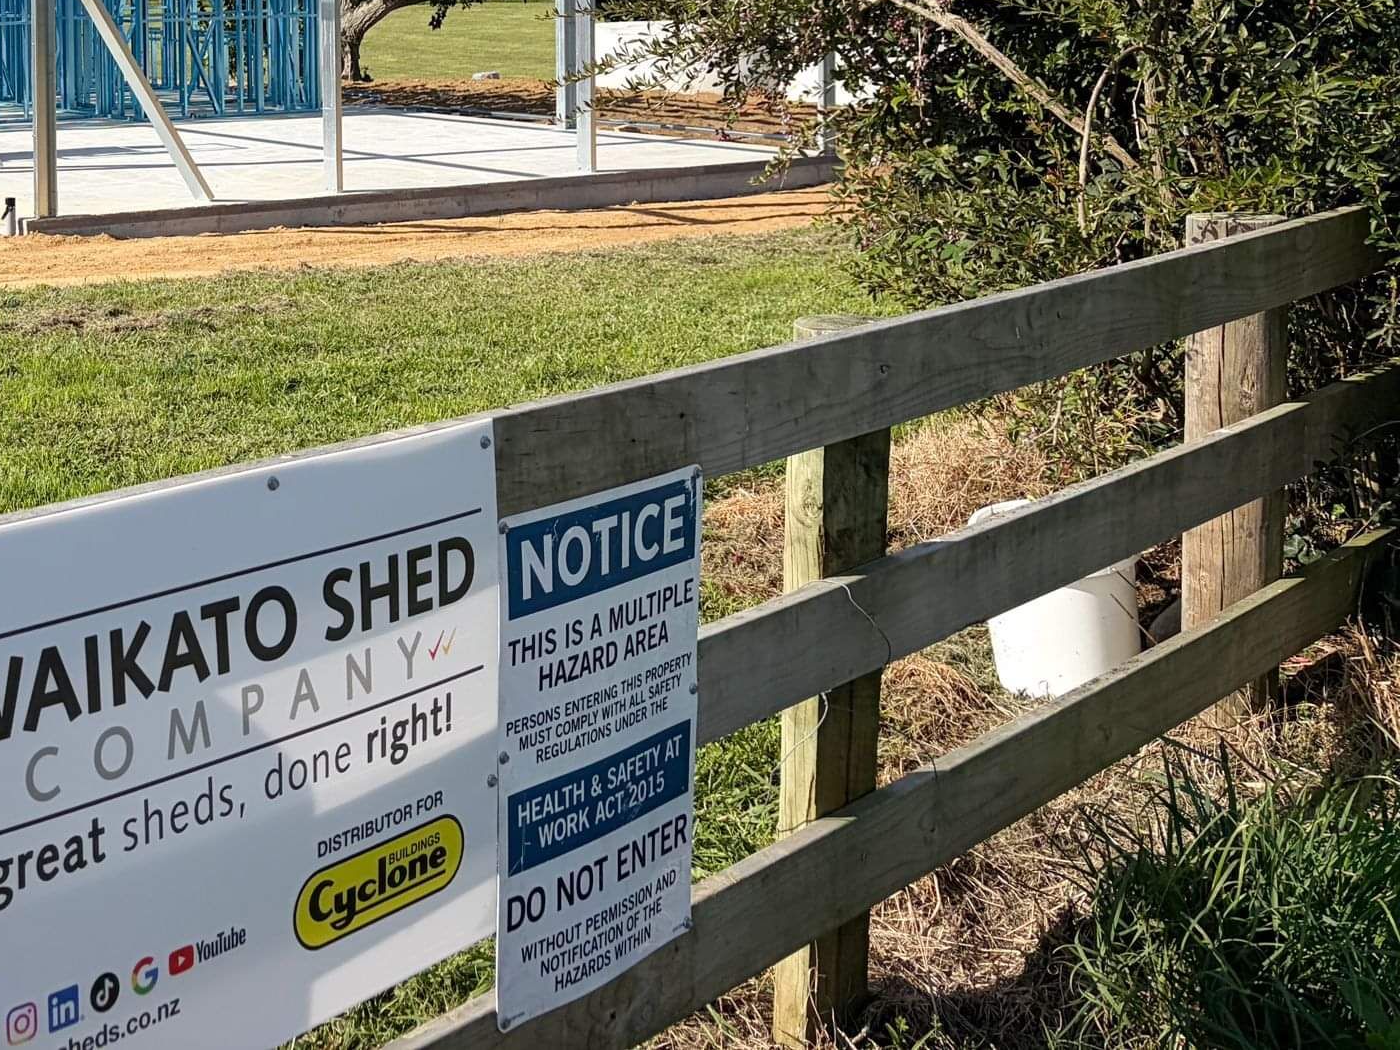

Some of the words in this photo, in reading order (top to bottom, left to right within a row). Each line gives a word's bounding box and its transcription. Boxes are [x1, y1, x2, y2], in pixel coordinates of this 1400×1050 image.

[323, 536, 475, 641] SHED
[521, 494, 686, 600] NOTICE
[508, 628, 556, 666] THIS
[566, 620, 583, 648] IS
[590, 613, 602, 640] A
[609, 578, 694, 632] MULTIPLE
[539, 641, 618, 691] HAZARD
[624, 620, 669, 660] AREA
[25, 631, 421, 802] COMPANY
[506, 706, 560, 736] PERSONS
[564, 685, 618, 716] ENTERING
[621, 674, 642, 694] THIS
[646, 652, 692, 682] PROPERTY
[519, 727, 552, 750] MUST
[556, 710, 599, 738] COMPLY
[602, 699, 626, 720] WITH
[628, 693, 645, 709] ALL
[648, 674, 682, 699] SAFETY
[536, 727, 612, 763] REGULATIONS
[616, 708, 647, 732] UNDER
[650, 696, 668, 715] THE
[123, 776, 246, 851] sheds,
[265, 752, 351, 799] done
[366, 692, 452, 765] right!
[518, 780, 585, 827] HEALTH
[590, 774, 602, 797] &
[608, 744, 661, 790] SAFETY
[664, 734, 683, 762] AT
[538, 807, 590, 848] WORK
[595, 791, 624, 824] ACT
[629, 770, 665, 808] 2015
[318, 804, 412, 857] DISTRIBUTOR
[416, 790, 443, 815] FOR
[389, 832, 441, 865] BUILDINGS
[309, 846, 447, 930] Cyclone
[507, 886, 546, 932] DO
[557, 855, 608, 911] NOT
[617, 814, 688, 882] ENTER
[521, 922, 582, 963] WITHOUT
[586, 882, 652, 934] PERMISSION
[656, 869, 676, 894] AND
[540, 924, 623, 977] NOTIFICATION
[626, 910, 640, 932] OF
[644, 896, 663, 919] THE
[132, 956, 159, 995] G
[195, 927, 246, 963] YouTube
[555, 950, 611, 992] HAZARDS
[614, 926, 650, 960] WITHIN
